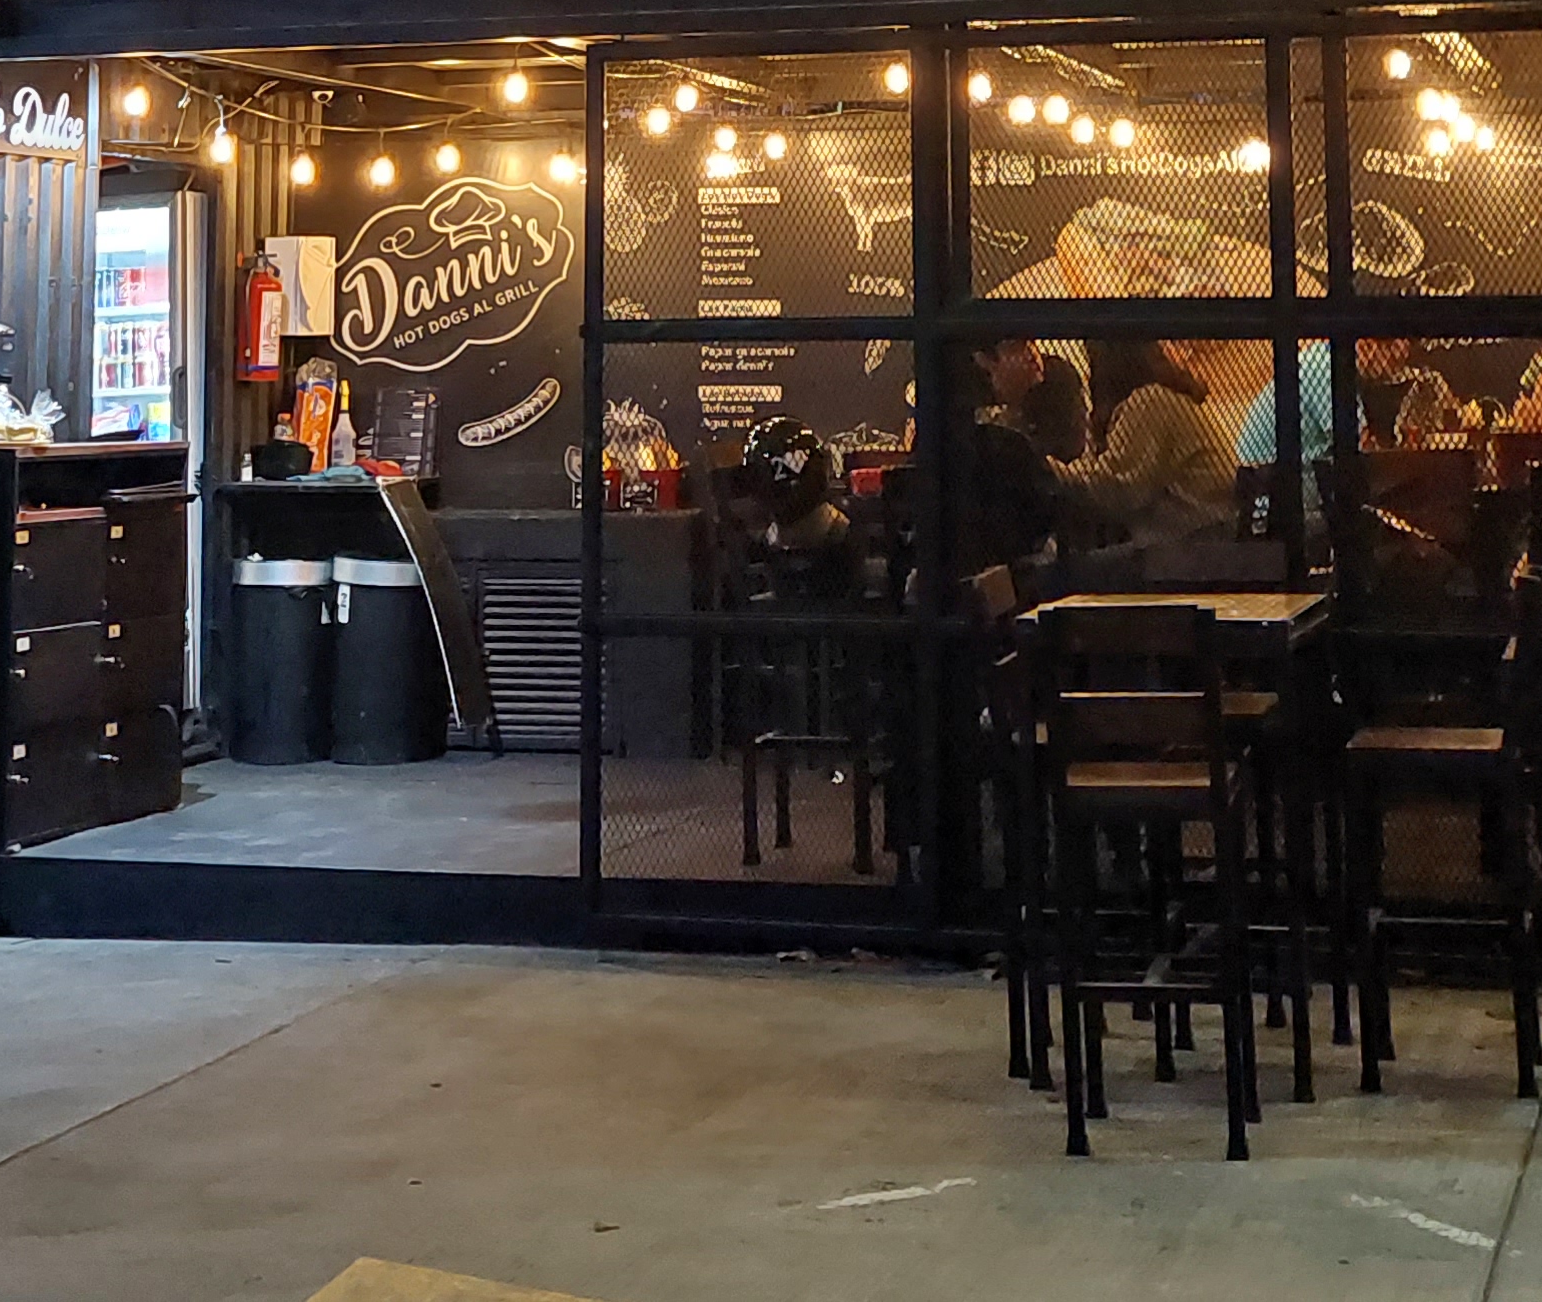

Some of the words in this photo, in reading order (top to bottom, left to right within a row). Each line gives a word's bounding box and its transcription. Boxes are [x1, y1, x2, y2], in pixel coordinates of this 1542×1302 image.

[10, 87, 86, 151] Dulce
[341, 214, 557, 352] Danni's
[393, 325, 425, 349] HOT
[428, 306, 470, 336] DOGS
[473, 299, 493, 318] AL
[495, 279, 540, 306] GRILL
